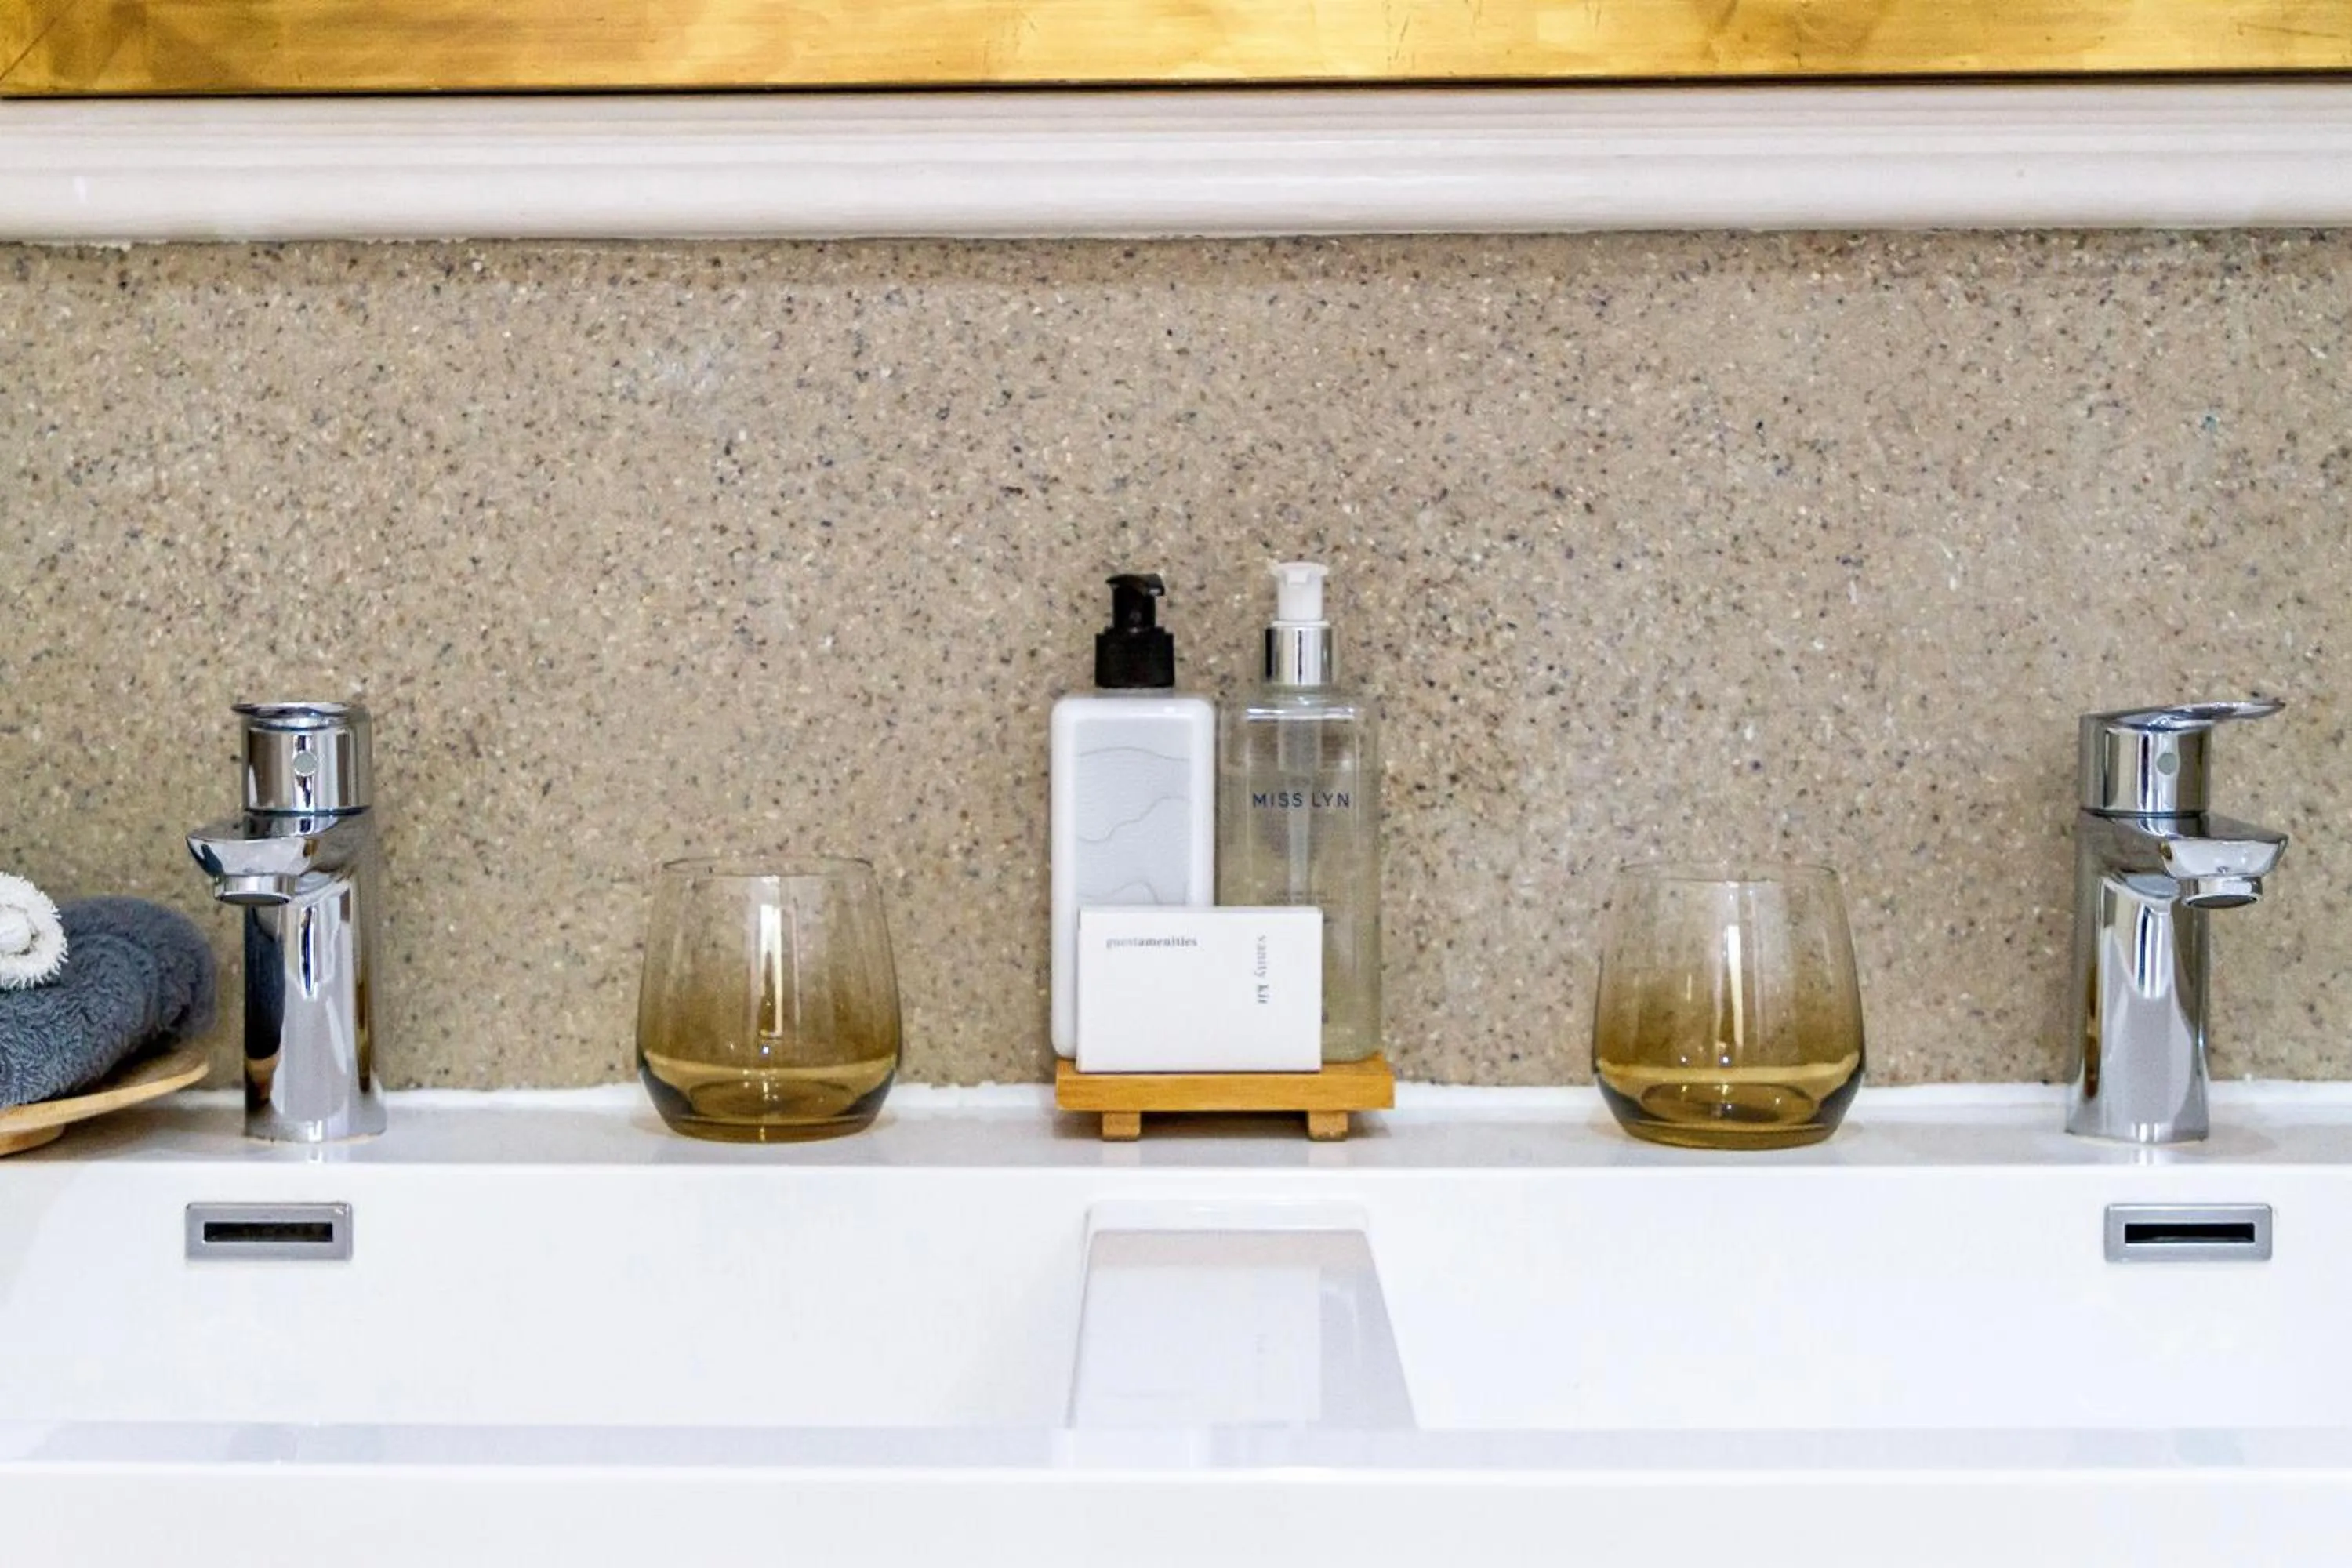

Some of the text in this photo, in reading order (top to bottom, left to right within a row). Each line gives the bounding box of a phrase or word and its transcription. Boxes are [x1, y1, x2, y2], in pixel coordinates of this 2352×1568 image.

[1252, 792, 1351, 808] MISS LYN
[1254, 935, 1269, 1004] vanity kit
